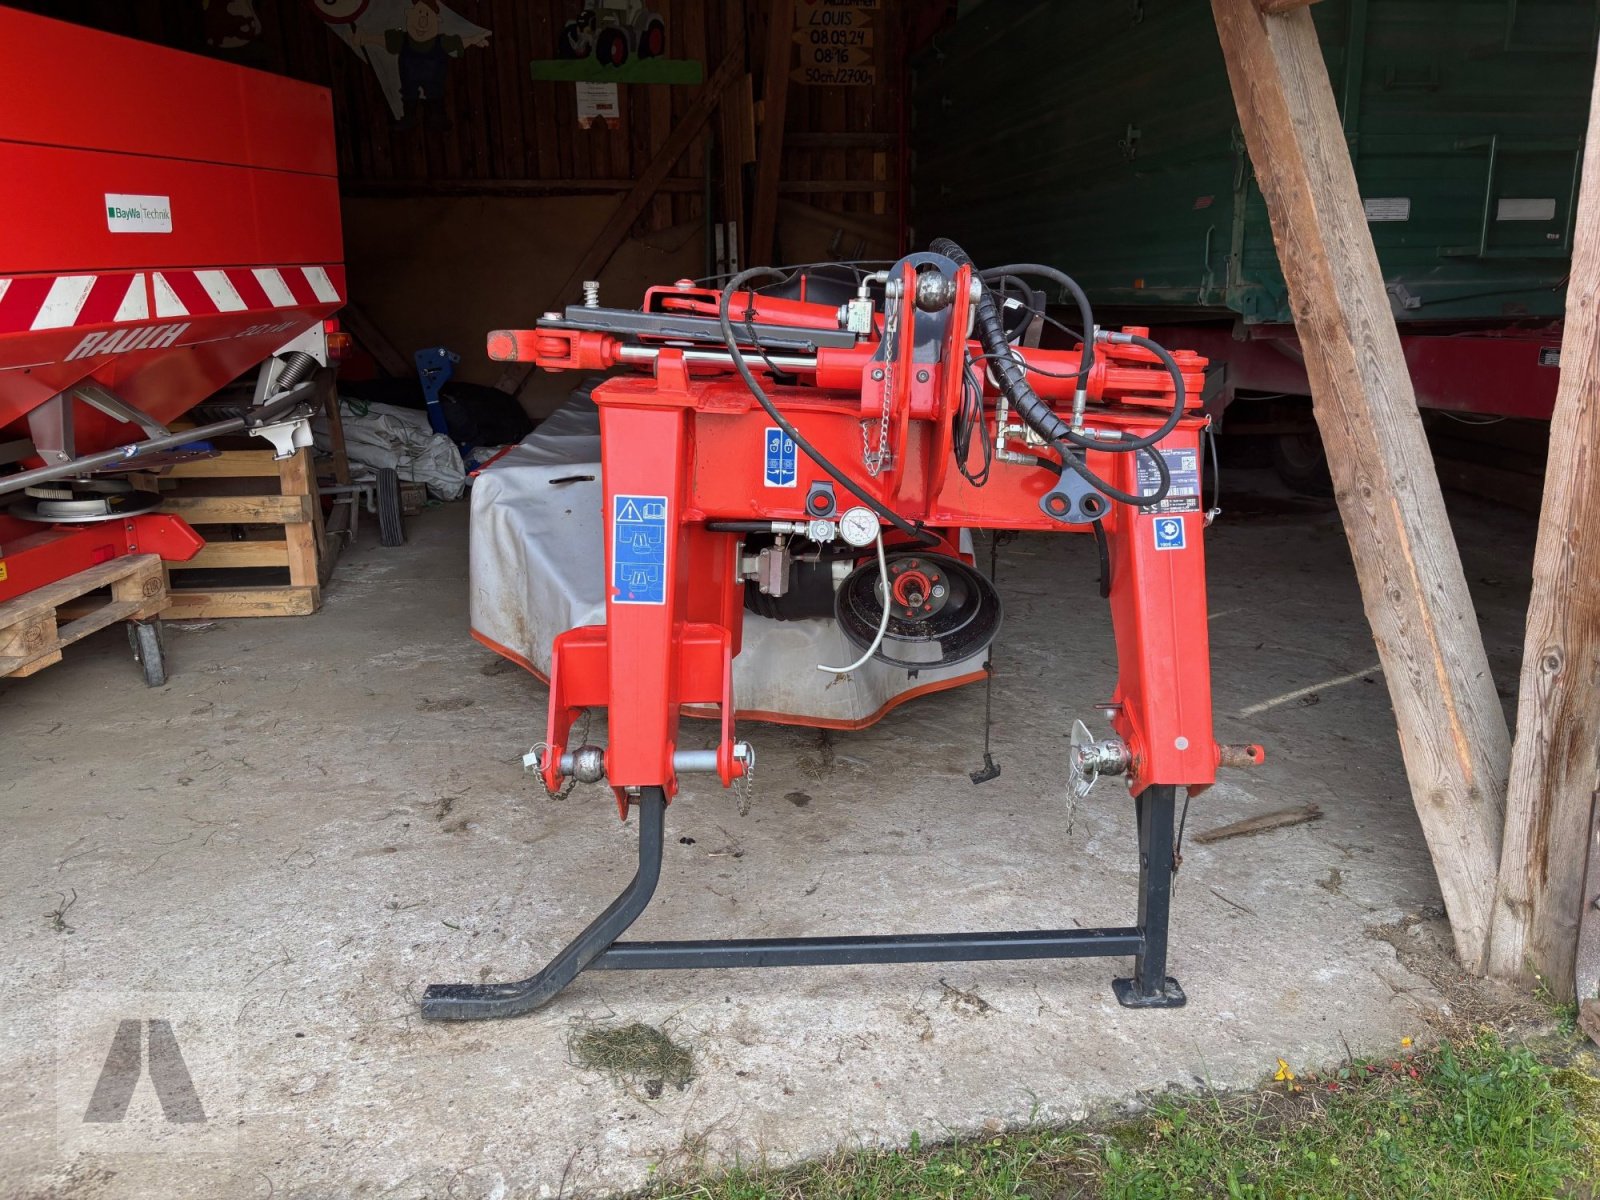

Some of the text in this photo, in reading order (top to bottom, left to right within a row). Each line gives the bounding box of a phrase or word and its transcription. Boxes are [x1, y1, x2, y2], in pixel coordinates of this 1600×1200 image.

[809, 10, 852, 26] LOUIS
[810, 29, 865, 47] 08.09.24
[115, 207, 170, 220] BayWa Technik
[64, 322, 192, 361] RAUCH
